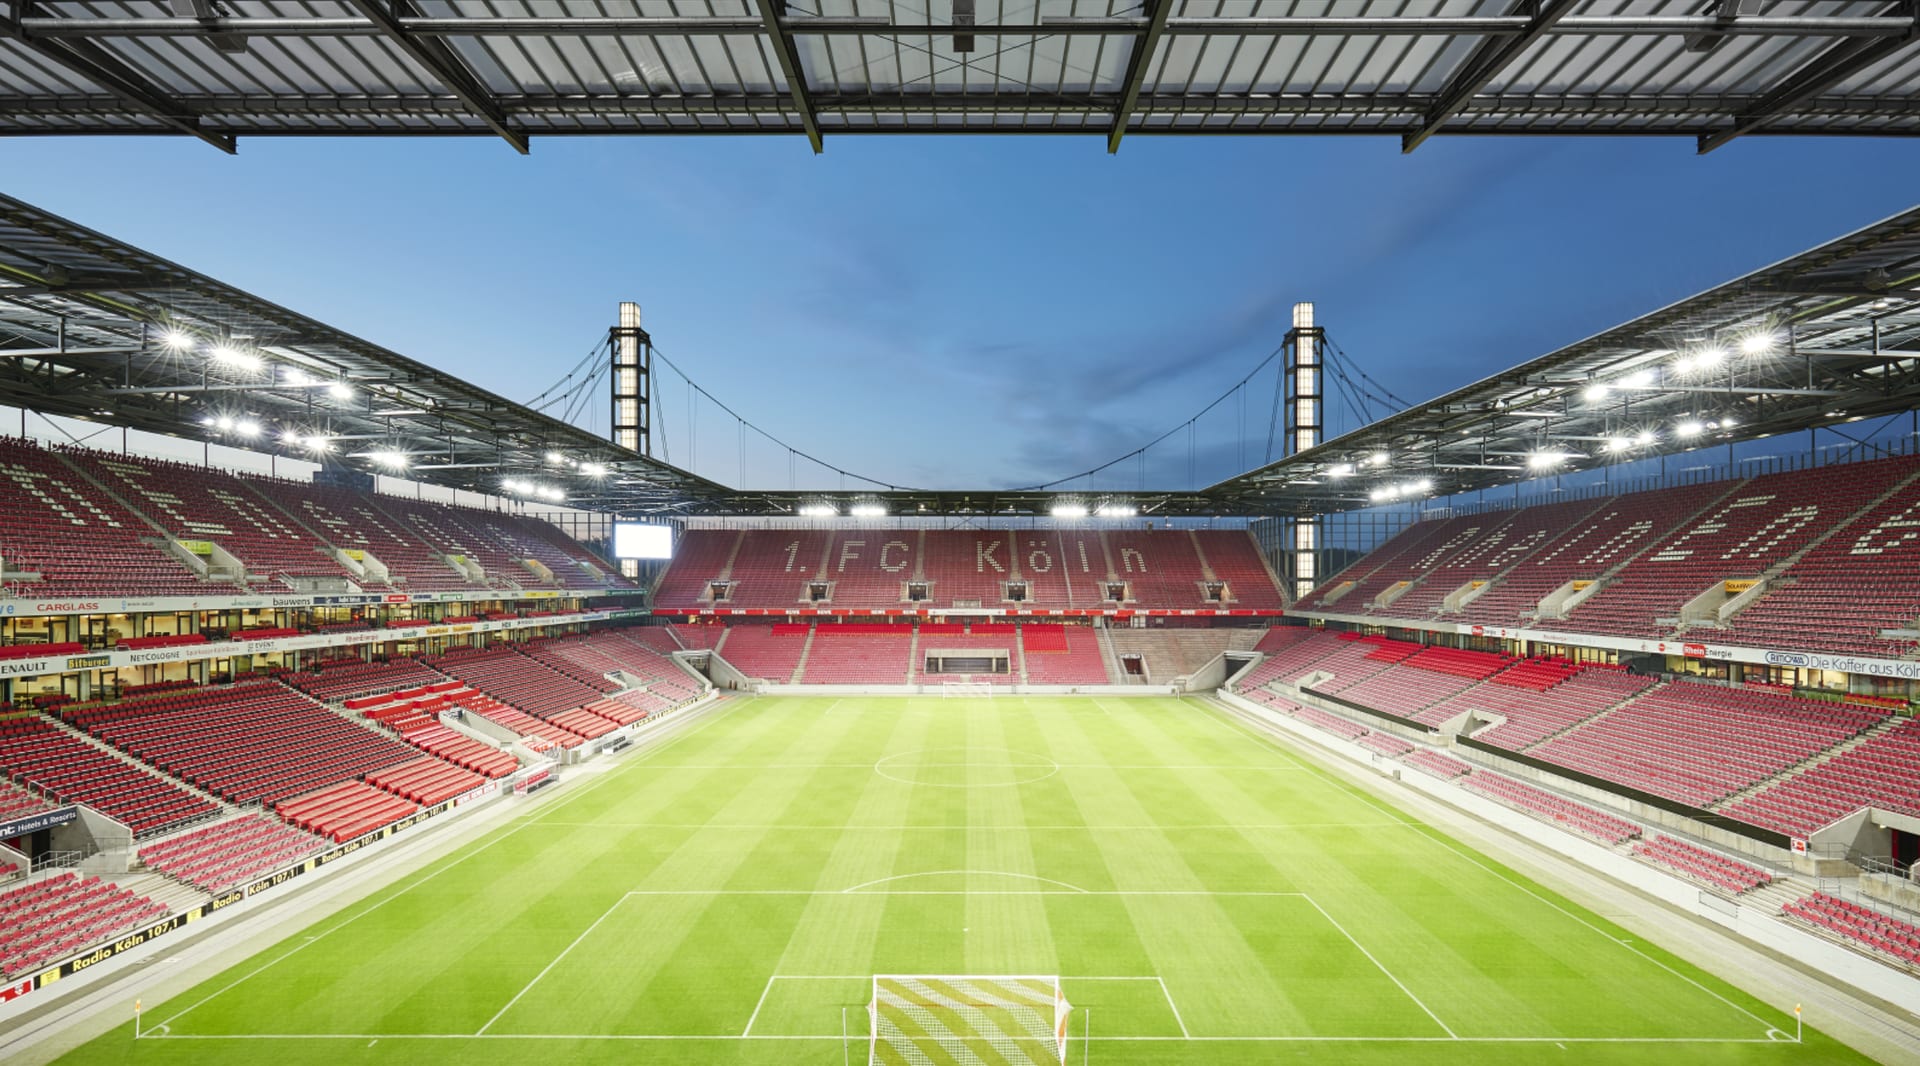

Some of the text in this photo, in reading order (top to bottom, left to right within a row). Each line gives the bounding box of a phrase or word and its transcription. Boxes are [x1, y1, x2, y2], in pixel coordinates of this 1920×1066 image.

[785, 540, 1147, 572] 1. FC Köln
[37, 602, 99, 612] CARGLASS
[272, 597, 310, 606] bauwens
[68, 657, 110, 669] Bitburger
[130, 650, 180, 662] NETCOLOGNE
[1811, 656, 1829, 668] Die
[1832, 657, 1865, 673] Koffer
[1869, 663, 1893, 675] aus
[18, 820, 41, 832] Hotels
[50, 812, 76, 824] Resorts
[213, 891, 241, 910] Radio
[249, 881, 270, 896] Köln
[72, 919, 178, 971] Radio Köln 107,1
